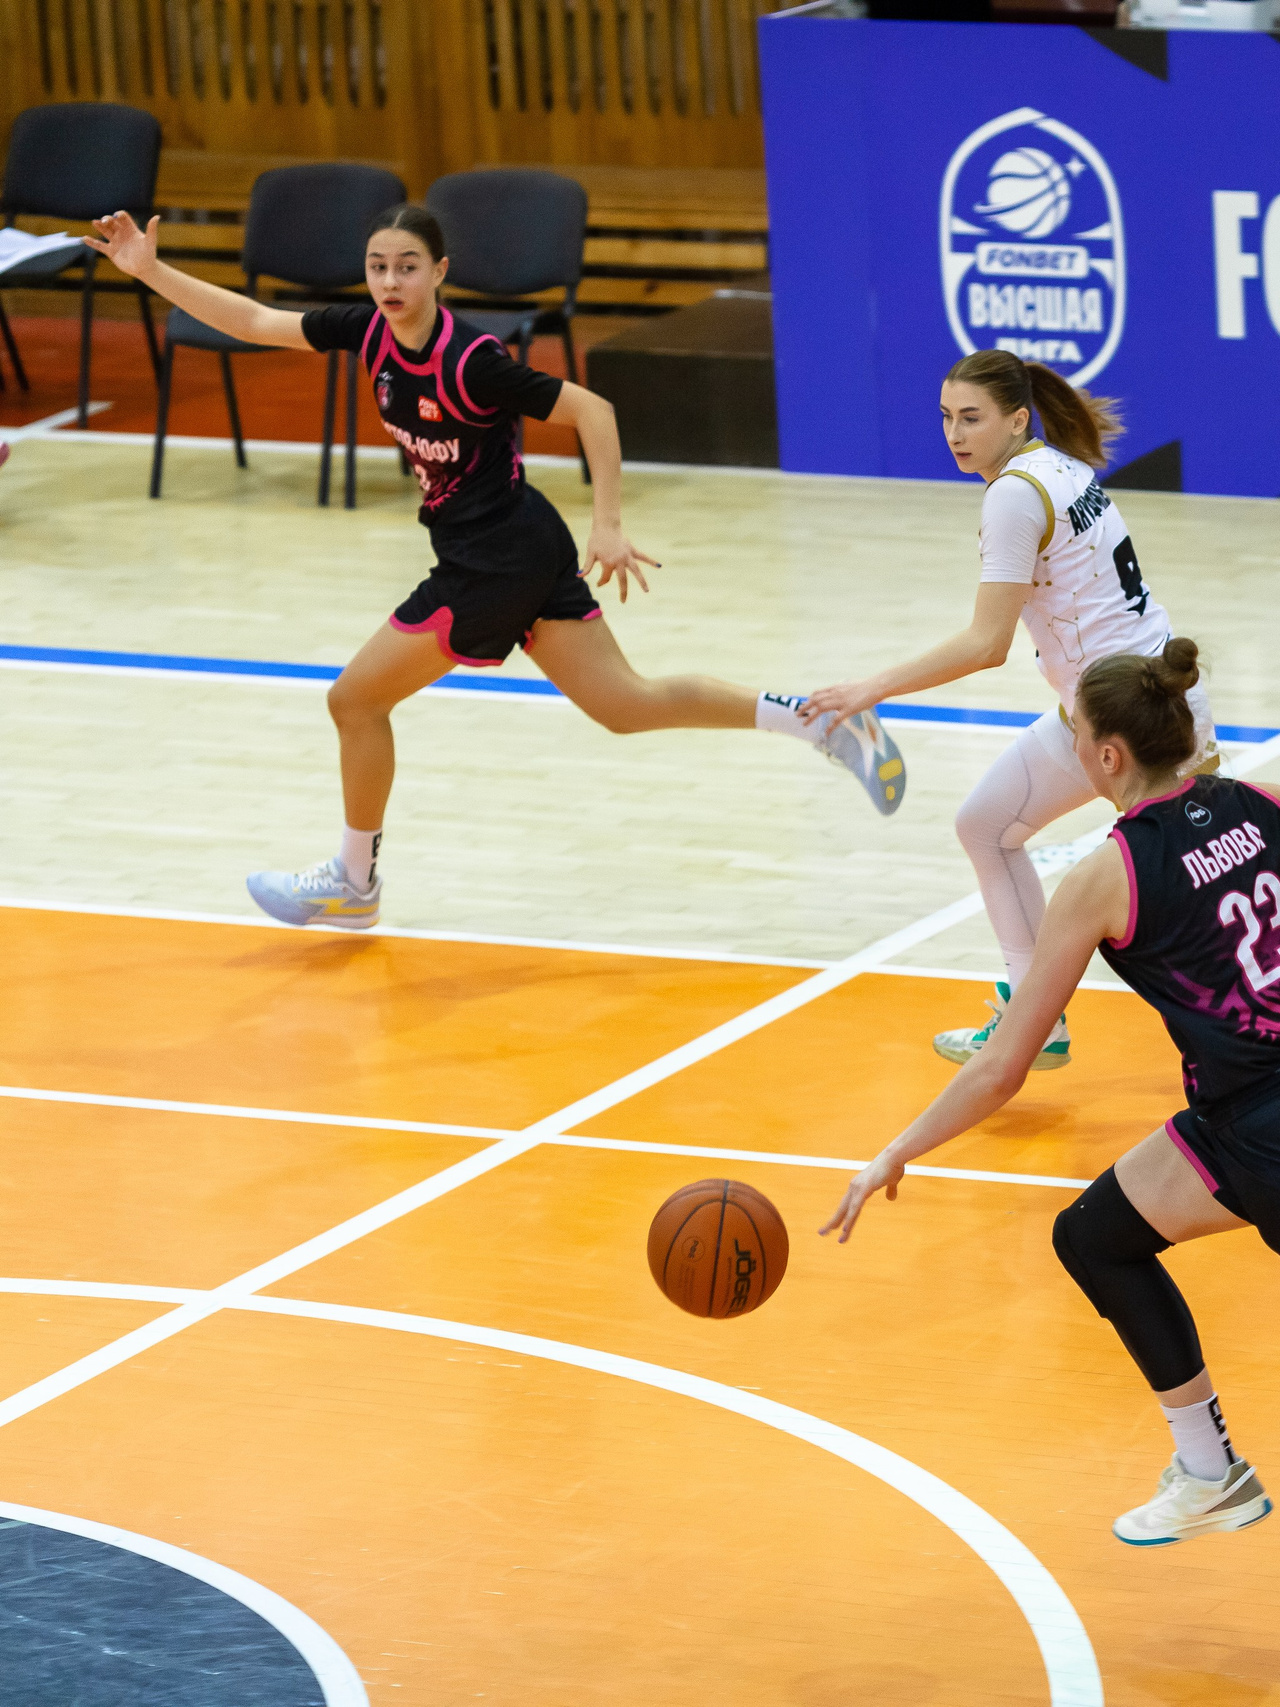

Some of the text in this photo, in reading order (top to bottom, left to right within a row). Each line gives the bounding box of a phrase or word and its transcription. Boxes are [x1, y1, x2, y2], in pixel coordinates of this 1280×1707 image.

[985, 248, 1078, 270] FONBET
[968, 282, 1103, 333] ВЫСШАЯ
[1181, 820, 1267, 889] ЛЬВОВА
